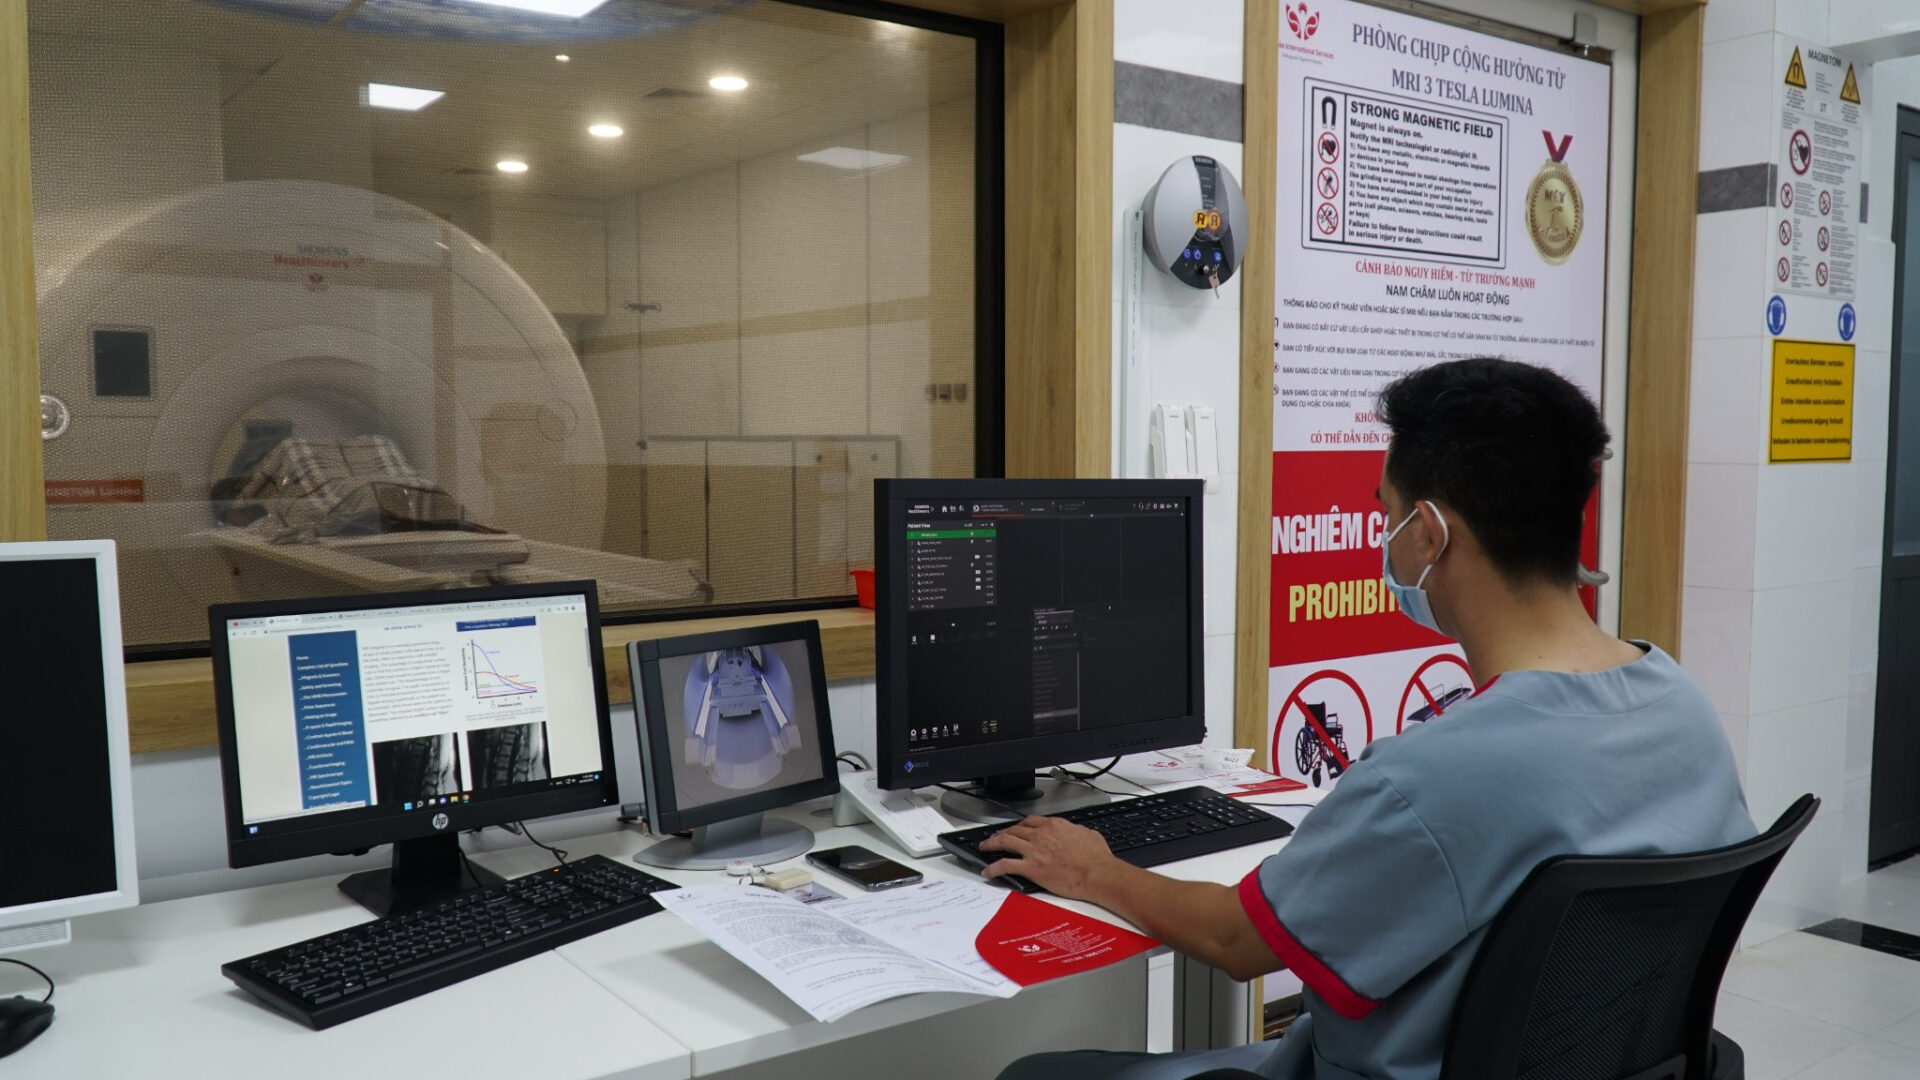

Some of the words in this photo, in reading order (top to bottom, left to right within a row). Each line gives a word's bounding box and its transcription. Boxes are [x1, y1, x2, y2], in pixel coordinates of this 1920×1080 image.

[1352, 24, 1407, 55] PHÒNG
[1410, 37, 1450, 69] CHỤP
[1453, 45, 1490, 76] CỘNG
[1493, 56, 1544, 86] HƯỞNG
[1546, 66, 1566, 91] TỪ
[1808, 48, 1842, 67] MAGNETOM
[1392, 68, 1420, 92] MRI
[1424, 75, 1432, 95] 3
[1435, 77, 1479, 104] TESLA
[1482, 87, 1533, 116] LUMINA
[1350, 118, 1377, 131] Magnet
[1379, 123, 1385, 132] is
[1386, 125, 1410, 138] always
[1412, 131, 1423, 139] on.
[1351, 101, 1399, 121] STRONG
[1402, 111, 1460, 133] MAGNETIC
[1463, 122, 1493, 139] FIELD
[1350, 131, 1369, 143] Notify
[1370, 135, 1380, 143] the
[1382, 136, 1394, 145] MRI
[1395, 139, 1432, 153] technologist
[1440, 147, 1470, 159] radiologist
[1349, 218, 1369, 228] Failure
[1379, 222, 1397, 232] follow
[1398, 225, 1415, 234] these
[1416, 226, 1449, 238] instructions
[1450, 231, 1466, 240] could
[1466, 234, 1482, 242] result
[1349, 228, 1355, 236] in
[1356, 230, 1378, 239] serious
[1379, 232, 1397, 244] injury
[1405, 235, 1423, 244] death.
[1355, 259, 1380, 274] CẢNH
[1384, 261, 1402, 276] BÁO
[1405, 266, 1429, 279] NGUY
[1460, 268, 1473, 283] TỪ
[1475, 271, 1510, 286] TRƯỜNG
[1511, 276, 1535, 290] MẠNH
[1386, 285, 1408, 297] NAM
[1410, 285, 1436, 299] CHÂM
[1439, 287, 1461, 301] LUÔN
[1463, 291, 1484, 305] HOẠT
[1486, 291, 1510, 307] ĐỘNG
[1355, 410, 1384, 424] KHÔN
[1310, 429, 1322, 443] CÓ
[1325, 429, 1342, 443] THỂ
[1343, 429, 1361, 443] DẪN
[1363, 429, 1380, 443] ĐẾN
[1272, 505, 1363, 554] NGHIÊM
[1289, 577, 1402, 622] PROHIBIT
[434, 813, 447, 829] hp
